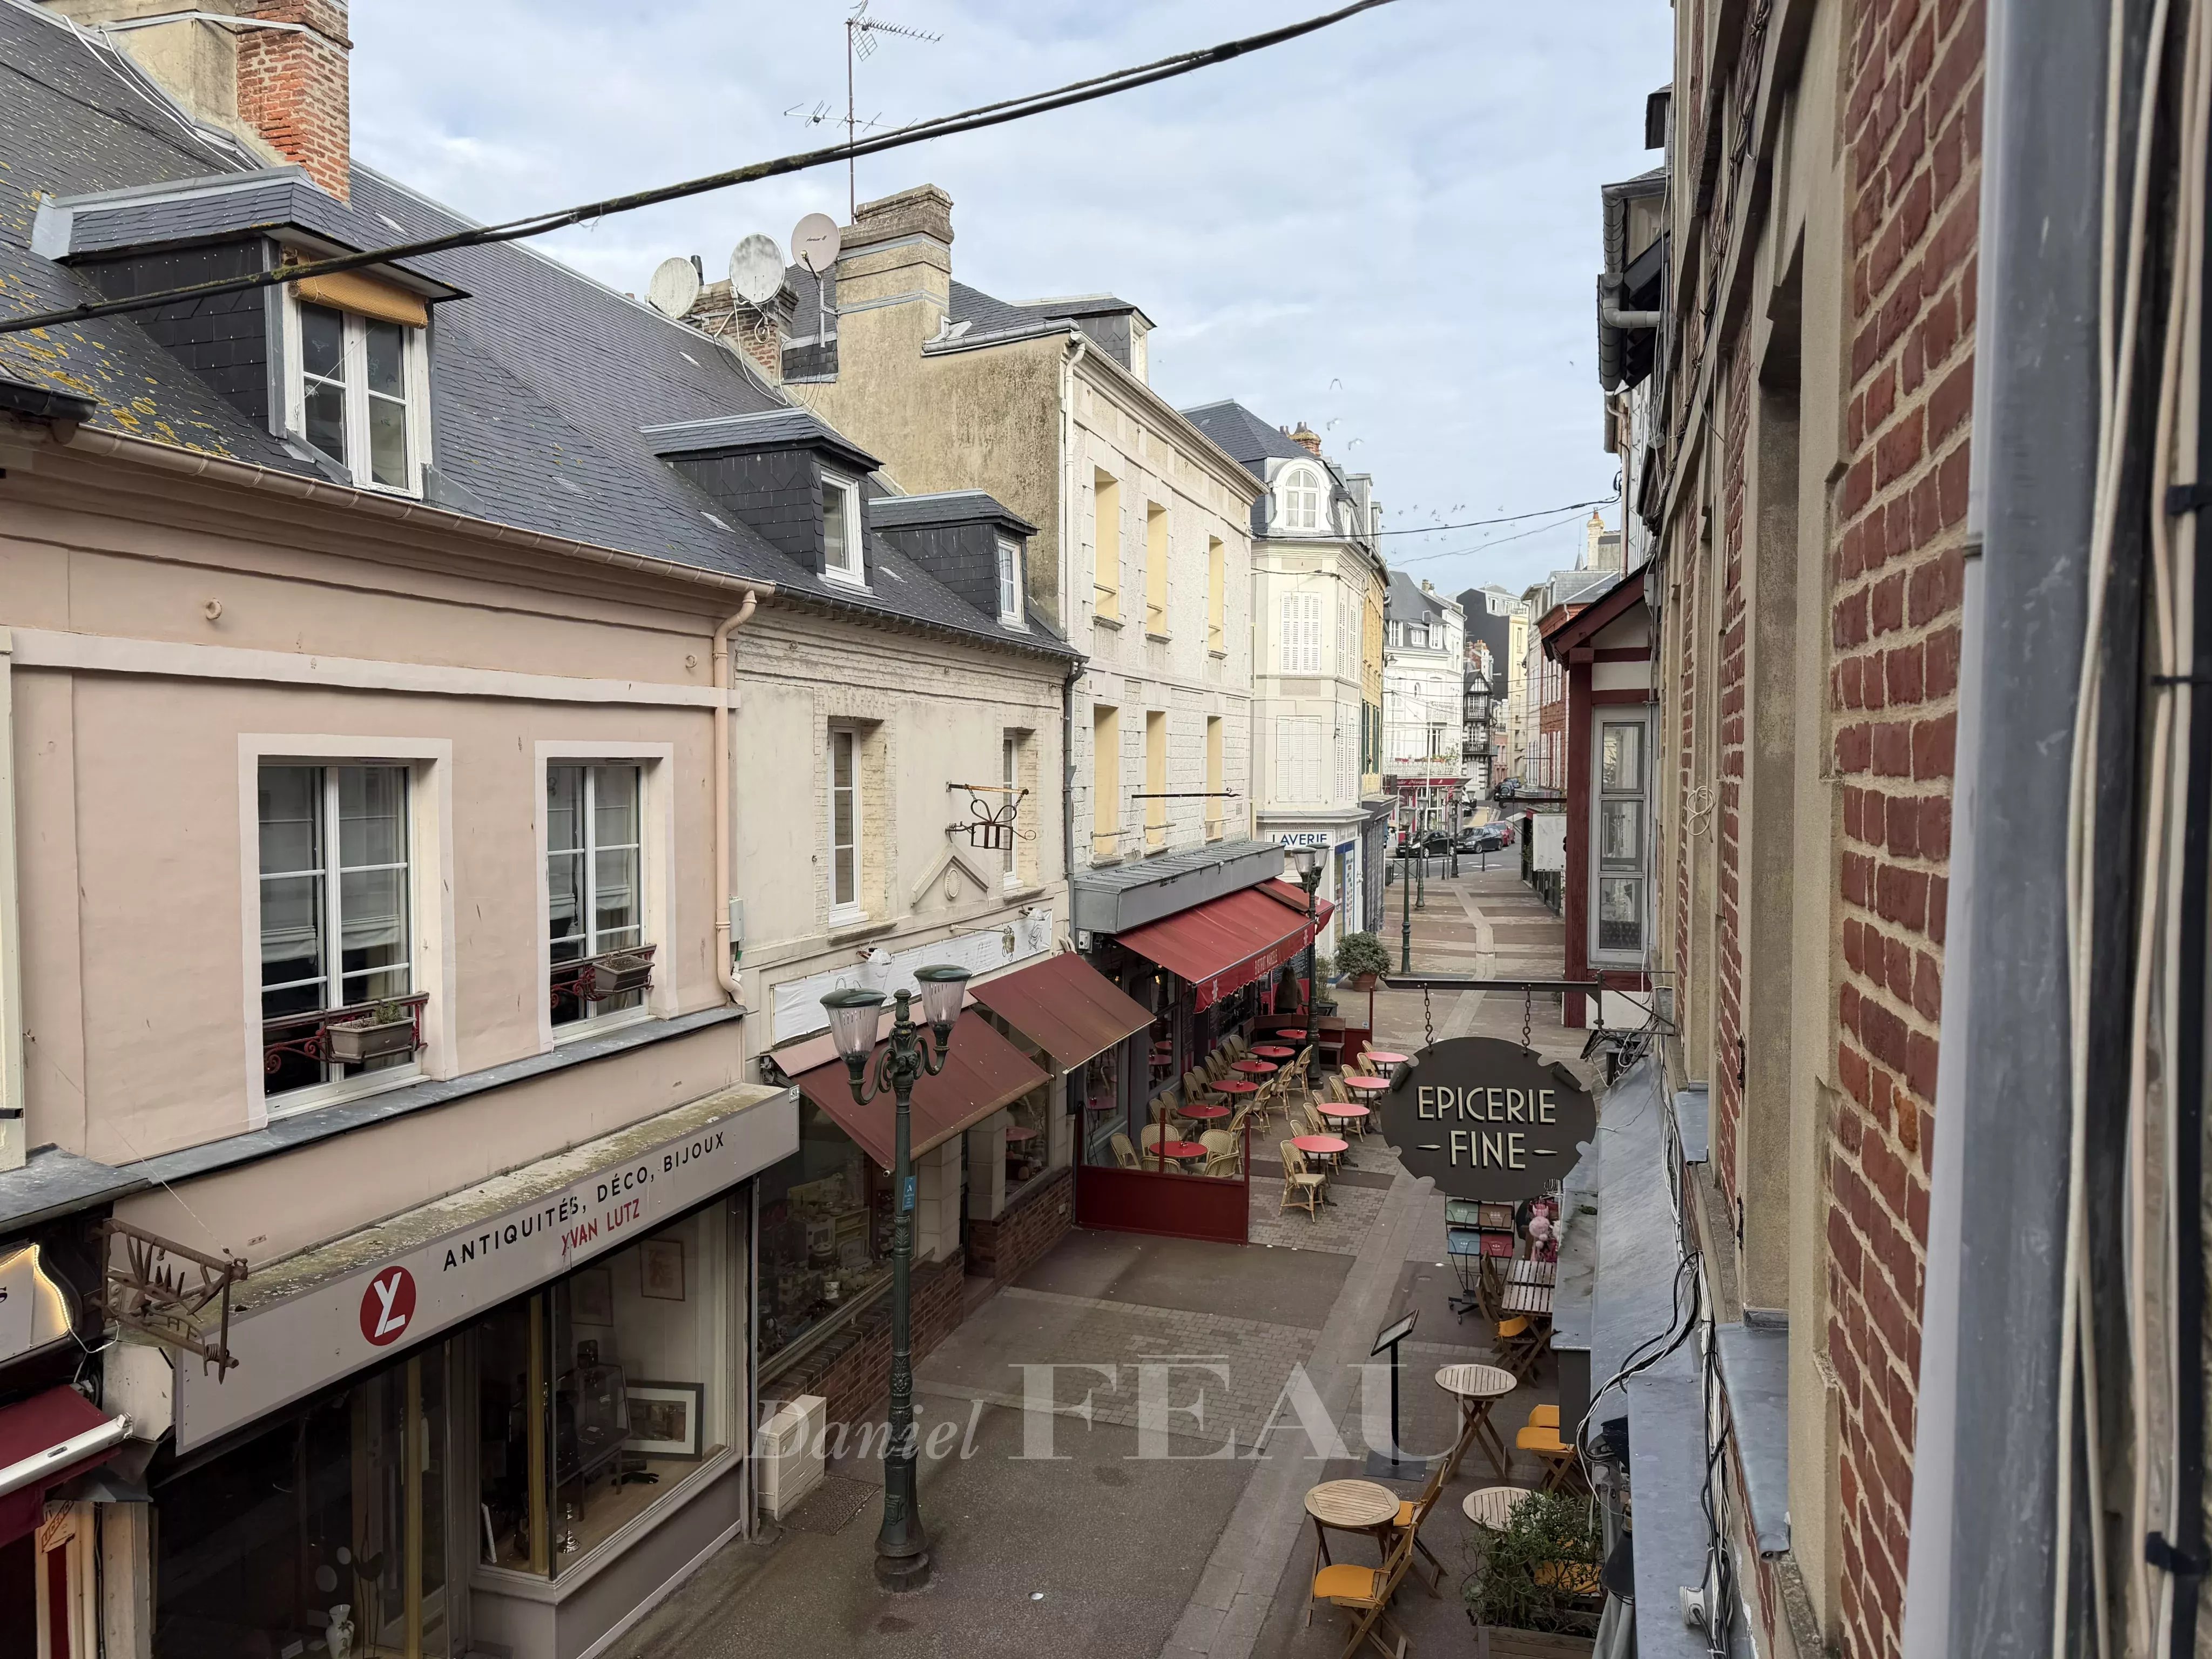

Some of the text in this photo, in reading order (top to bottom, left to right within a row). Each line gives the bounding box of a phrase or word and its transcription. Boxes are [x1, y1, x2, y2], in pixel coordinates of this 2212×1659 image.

[1417, 1086, 1556, 1124] EPICERIE
[1449, 1130, 1526, 1170] FINE
[443, 1131, 725, 1271] ANTIQUITÉS, DÉCO, BIJOUX
[561, 1198, 640, 1256] YVAN LUTZ
